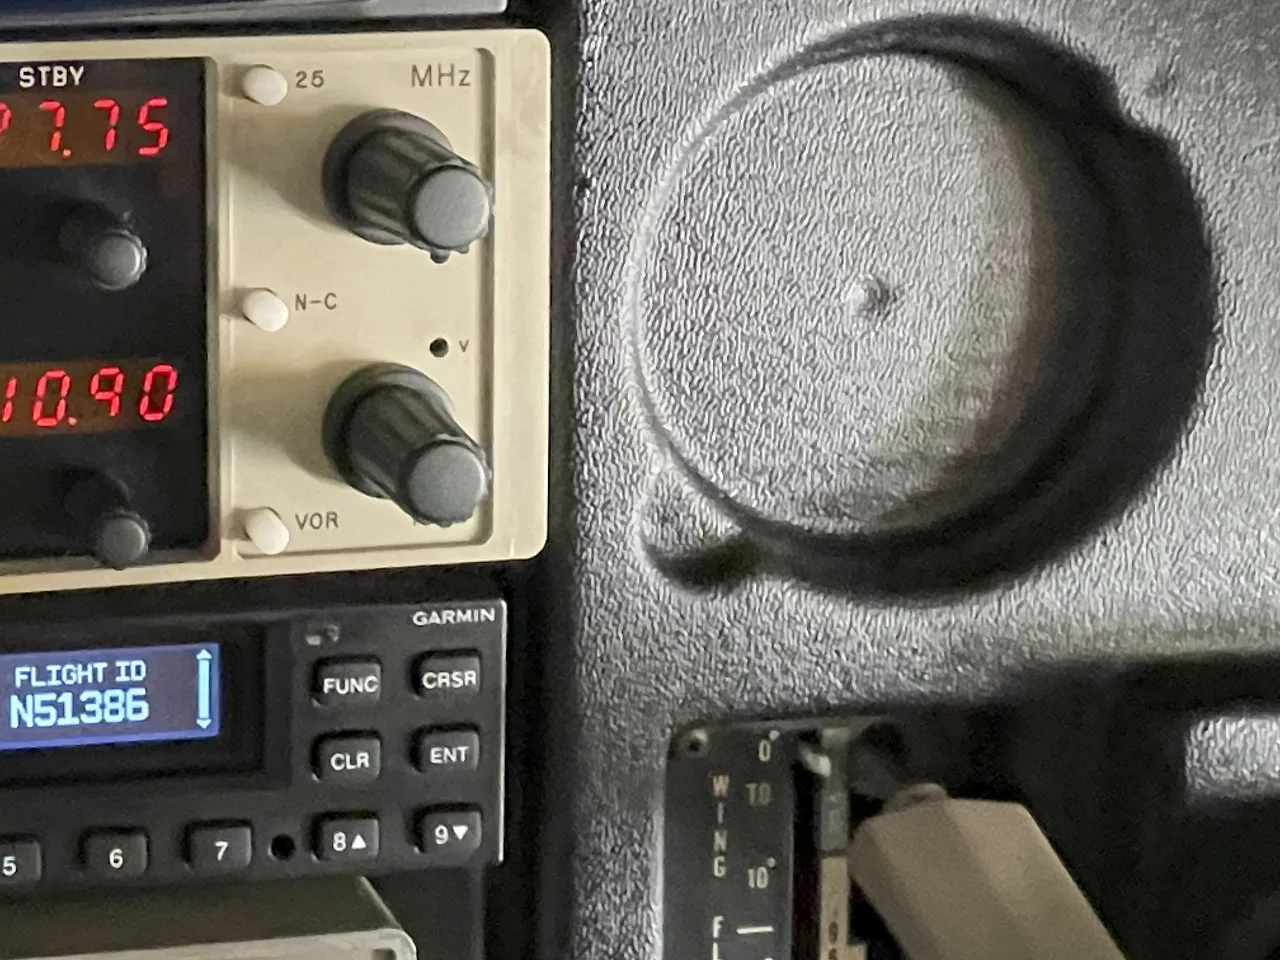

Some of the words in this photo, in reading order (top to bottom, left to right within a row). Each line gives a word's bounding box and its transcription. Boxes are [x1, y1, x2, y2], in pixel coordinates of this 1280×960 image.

[19, 66, 84, 88] STBY
[296, 70, 324, 88] 25
[411, 63, 471, 87] MHz
[294, 292, 337, 311] N-C
[295, 511, 339, 530] VOR
[412, 608, 496, 626] GARMIN
[15, 661, 109, 689] FLIGHT
[116, 660, 147, 683] ID
[323, 675, 378, 694] FUNC
[422, 671, 477, 690] CRSR
[10, 688, 150, 729] N51386
[330, 753, 369, 771] CLR
[430, 746, 469, 764] ENT
[332, 832, 346, 852] 8
[434, 825, 448, 845] 9
[109, 848, 124, 868] 6
[214, 841, 228, 861] 7
[2, 856, 17, 876] 5
